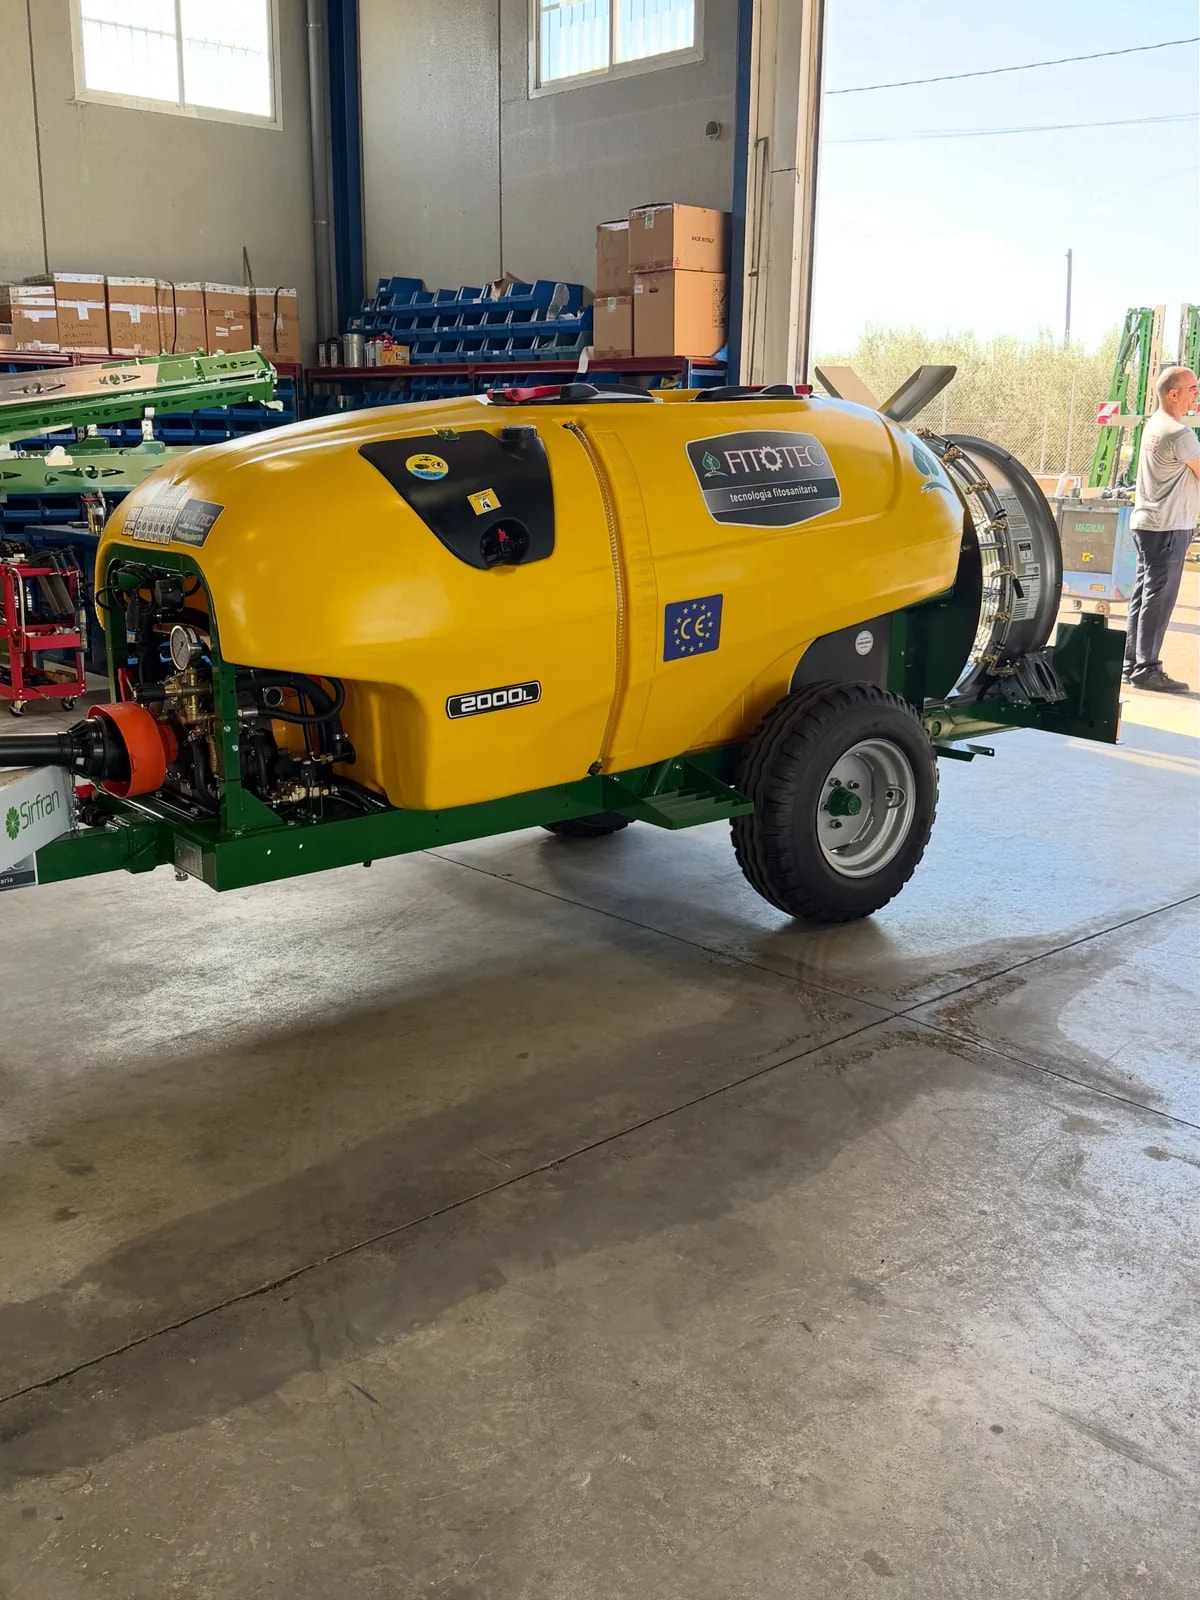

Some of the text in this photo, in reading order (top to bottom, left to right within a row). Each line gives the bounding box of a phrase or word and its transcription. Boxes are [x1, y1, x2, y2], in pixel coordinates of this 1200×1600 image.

[724, 446, 824, 474] FITOTEC
[730, 484, 818, 502] tecnologia fitosanitaria
[680, 615, 706, 640] CE
[20, 790, 60, 829] Sirfran
